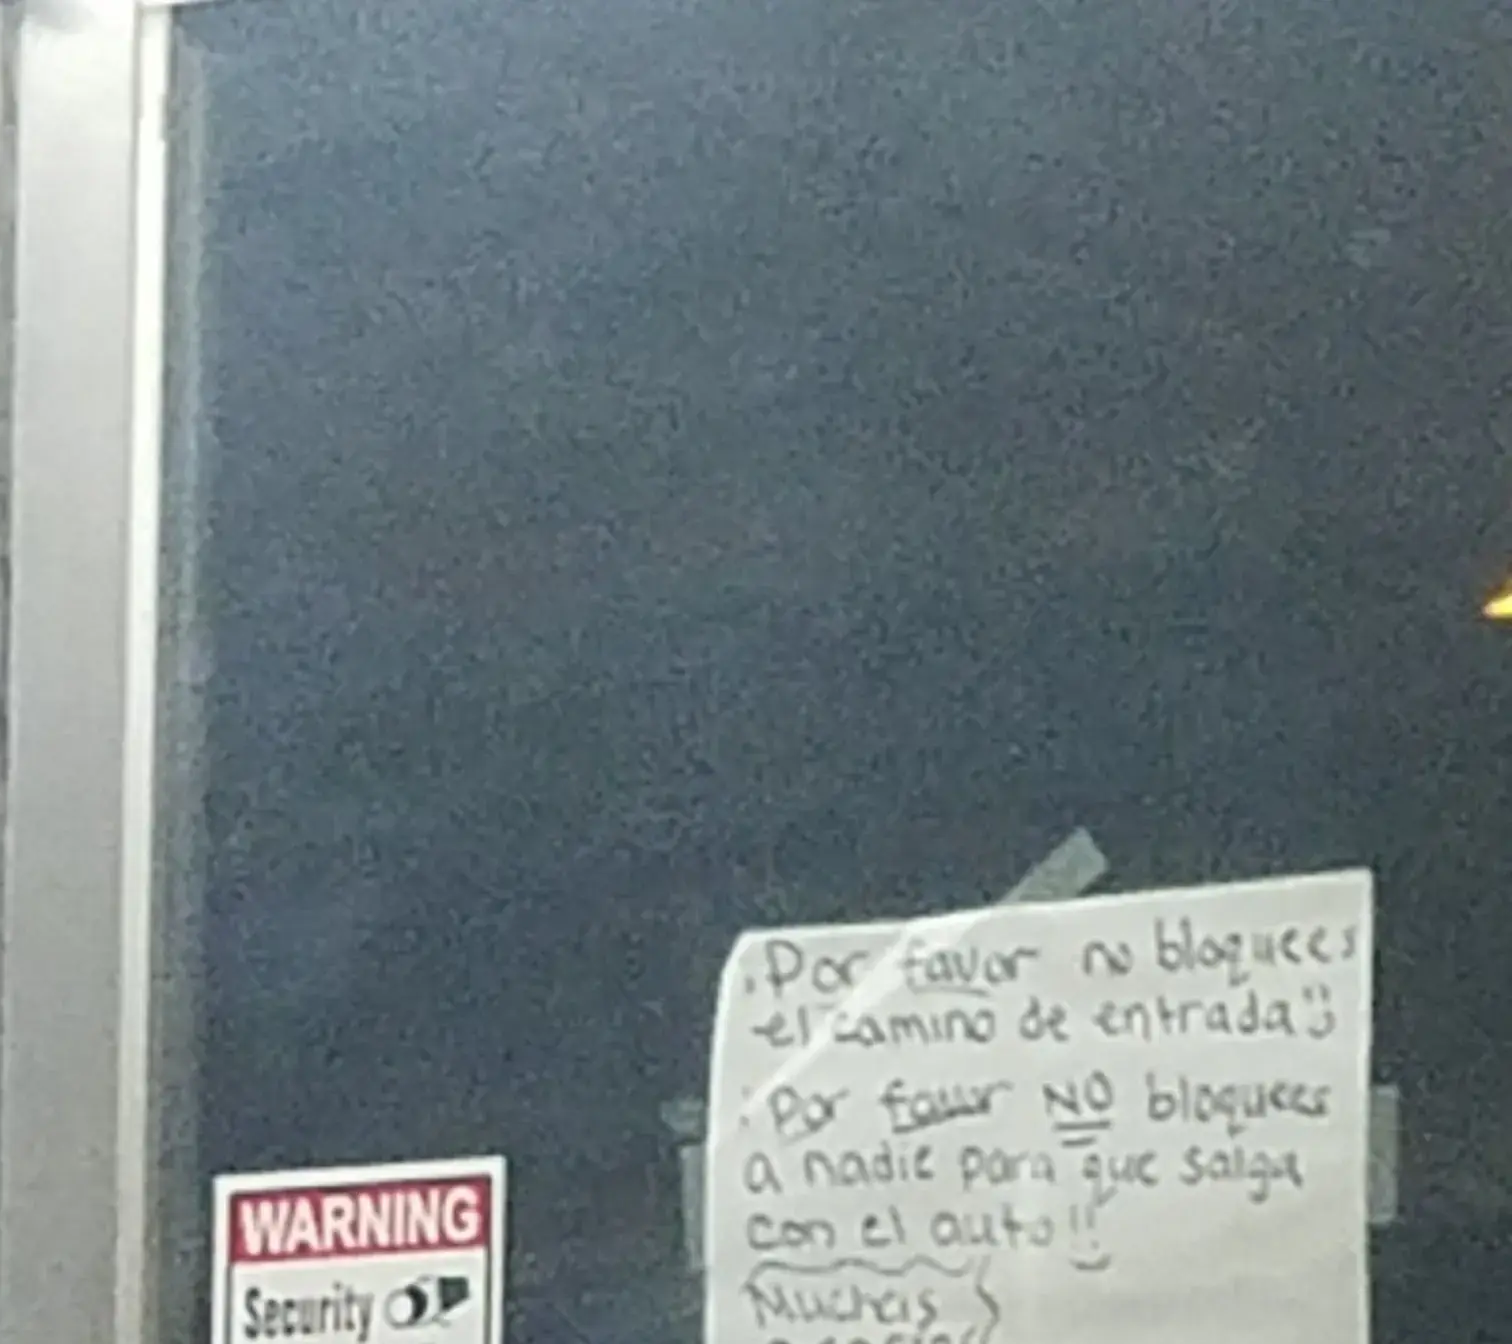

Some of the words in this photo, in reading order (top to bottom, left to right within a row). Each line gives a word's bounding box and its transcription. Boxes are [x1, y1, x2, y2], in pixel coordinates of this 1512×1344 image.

[766, 937, 872, 1000] Por
[902, 937, 1039, 995] favor
[751, 1003, 811, 1049] el
[832, 1008, 997, 1048] camino
[1018, 995, 1070, 1043] de
[767, 1083, 851, 1143] Por
[1043, 1068, 1114, 1118] NO
[743, 1149, 783, 1196] a
[802, 1140, 936, 1187] nadie
[958, 1145, 1056, 1193] para
[1081, 1151, 1160, 1208] que
[1179, 1144, 1306, 1205] salga
[238, 1185, 484, 1257] WARNING
[745, 1210, 837, 1251] con
[860, 1202, 907, 1248] el
[243, 1280, 375, 1343] Security
